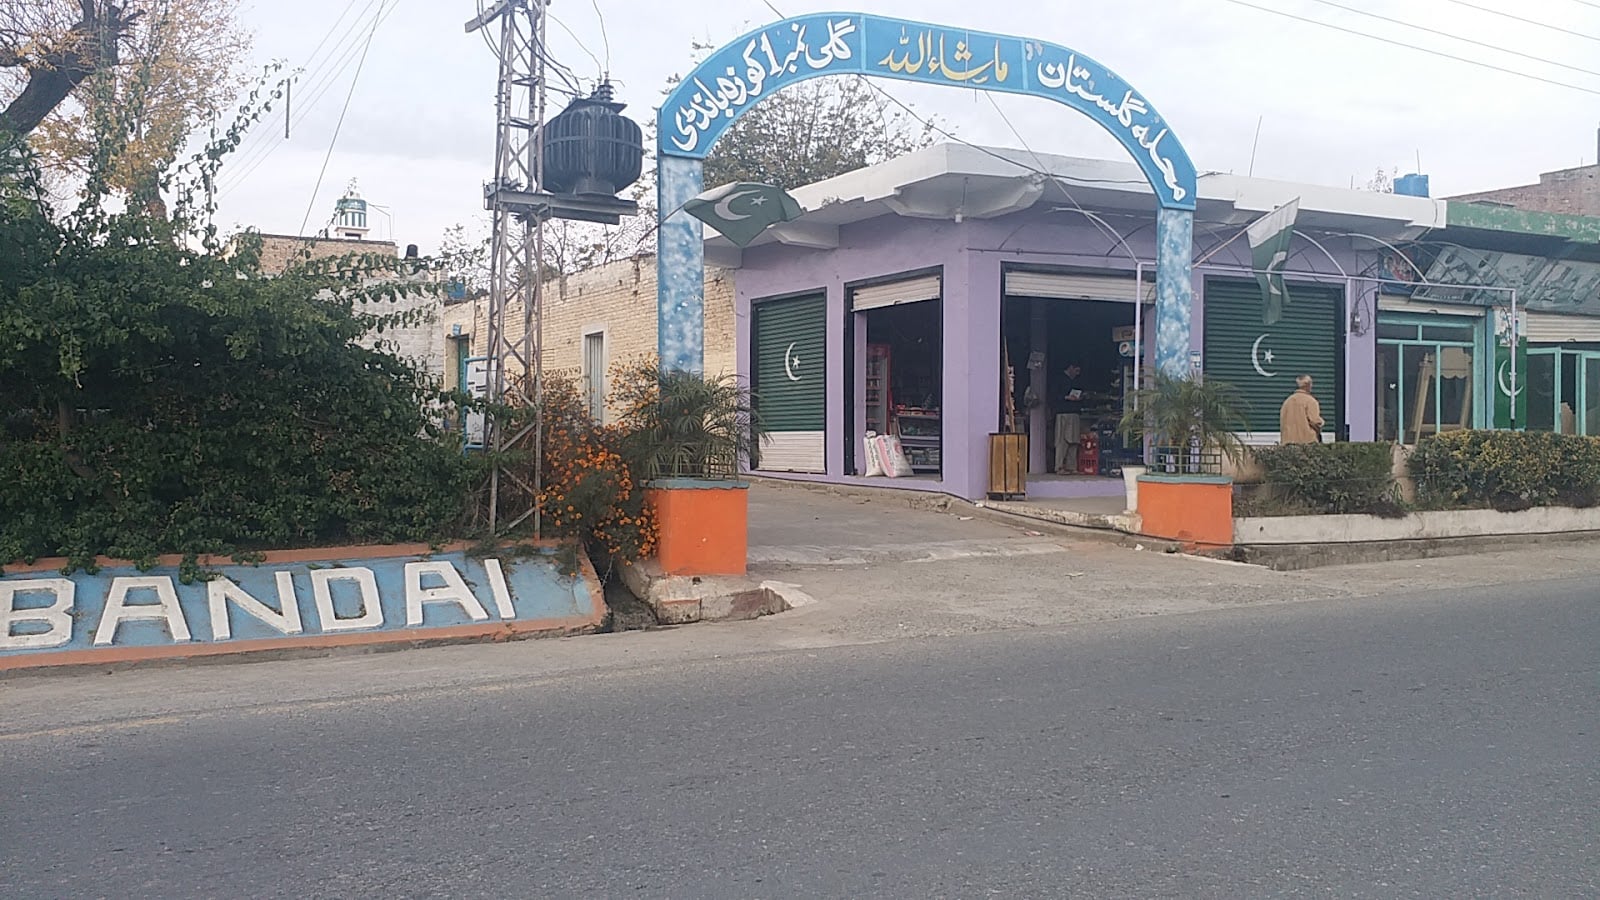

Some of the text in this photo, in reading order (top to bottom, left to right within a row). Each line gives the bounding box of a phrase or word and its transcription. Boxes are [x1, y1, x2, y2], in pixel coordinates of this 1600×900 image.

[805, 18, 856, 69] گلی
[1037, 53, 1148, 128] گلستان
[0, 558, 516, 650] BANDAI
